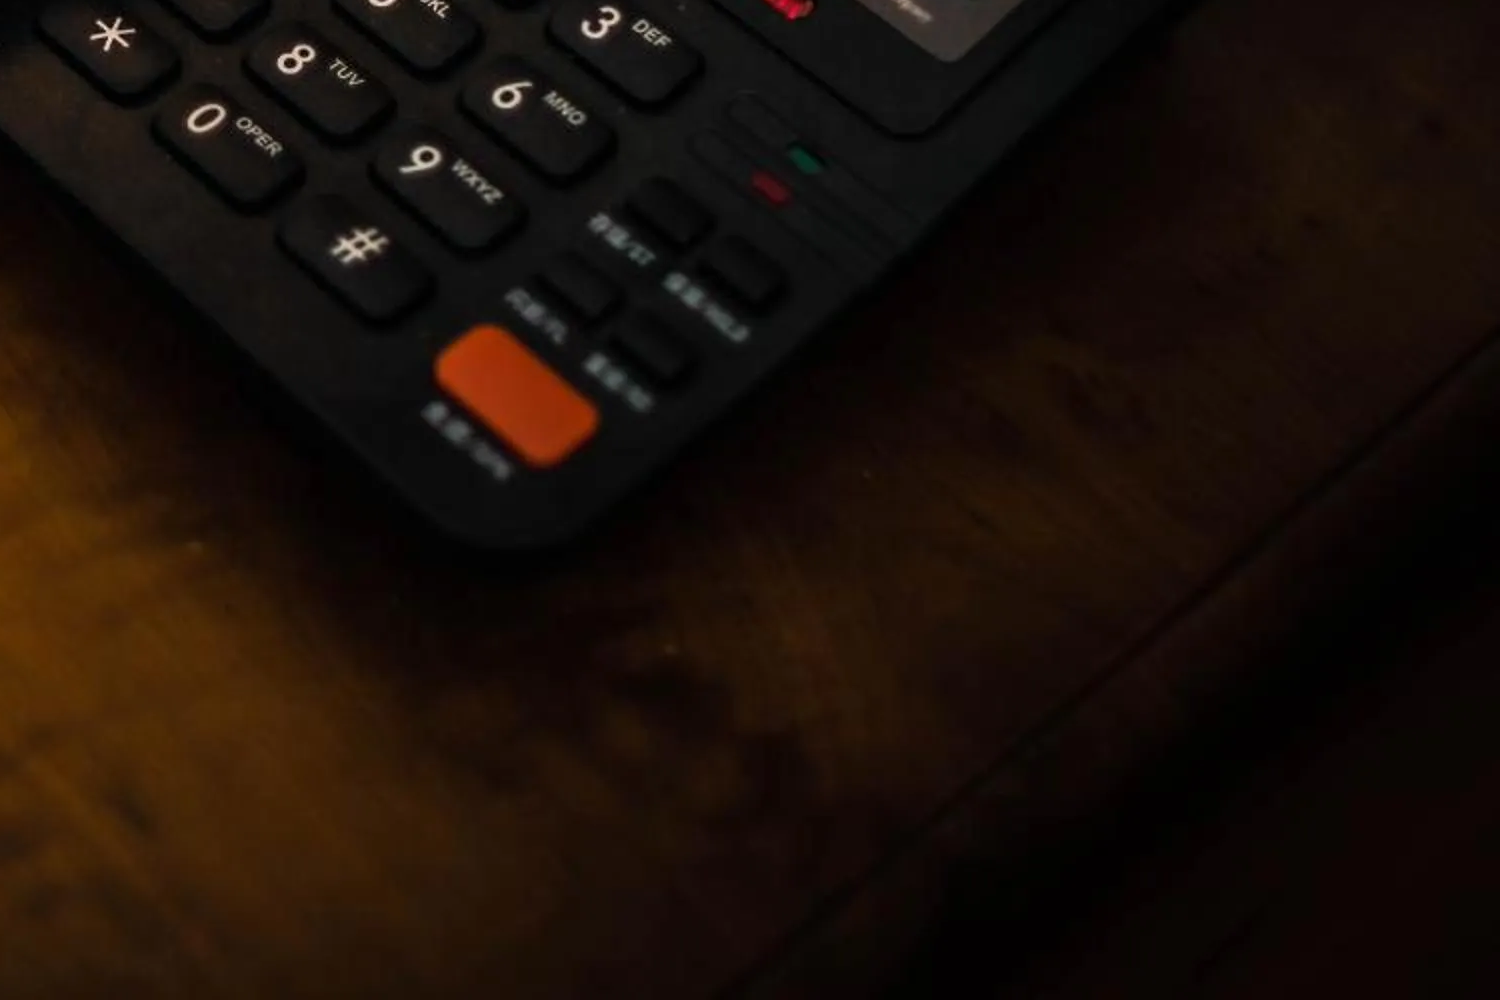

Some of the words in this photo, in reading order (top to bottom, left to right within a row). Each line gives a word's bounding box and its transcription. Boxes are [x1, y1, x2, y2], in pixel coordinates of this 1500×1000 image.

[580, 4, 623, 40] 3
[630, 17, 673, 48] DEF
[275, 42, 318, 76] 8
[327, 55, 367, 88] TUV
[490, 79, 534, 110] 6
[540, 89, 588, 127] MNO
[185, 102, 228, 135] 0
[234, 114, 284, 158] OPER
[397, 143, 444, 176] 9
[449, 156, 505, 205] WXYZ
[328, 226, 390, 267] #
